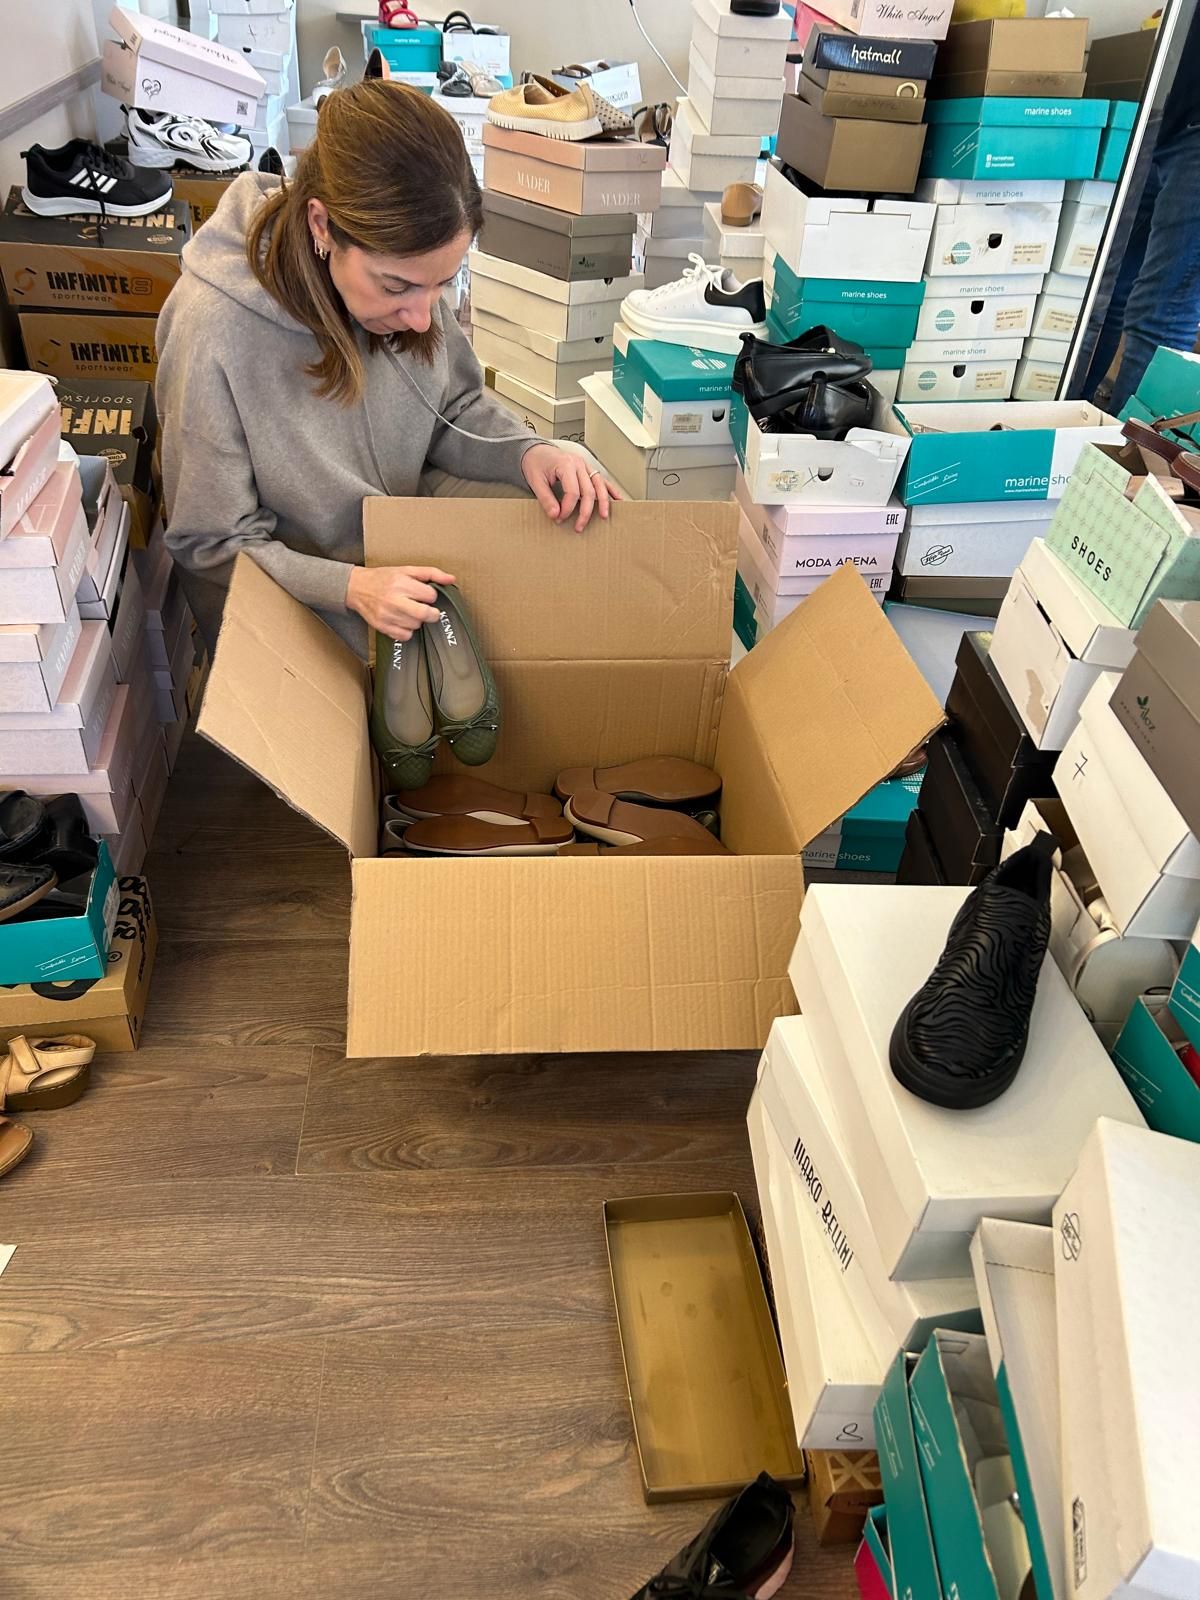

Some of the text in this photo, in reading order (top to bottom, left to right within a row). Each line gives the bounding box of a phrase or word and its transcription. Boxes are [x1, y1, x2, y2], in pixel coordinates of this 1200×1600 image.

[876, 4, 945, 26] White Angel
[851, 44, 902, 65] hatmall
[1024, 107, 1073, 117] marine shoes
[516, 170, 551, 194] MADER
[600, 192, 641, 207] MADER
[976, 188, 1024, 199] marine shoes
[52, 292, 114, 304] sportswear
[841, 291, 888, 300] marine shoes
[75, 364, 134, 373] sportswear
[699, 385, 723, 393] marine
[1005, 475, 1048, 488] marine
[795, 558, 832, 569] MODA
[1071, 535, 1113, 583] SHOES
[440, 611, 457, 647] KENNZ
[838, 851, 871, 862] shoes
